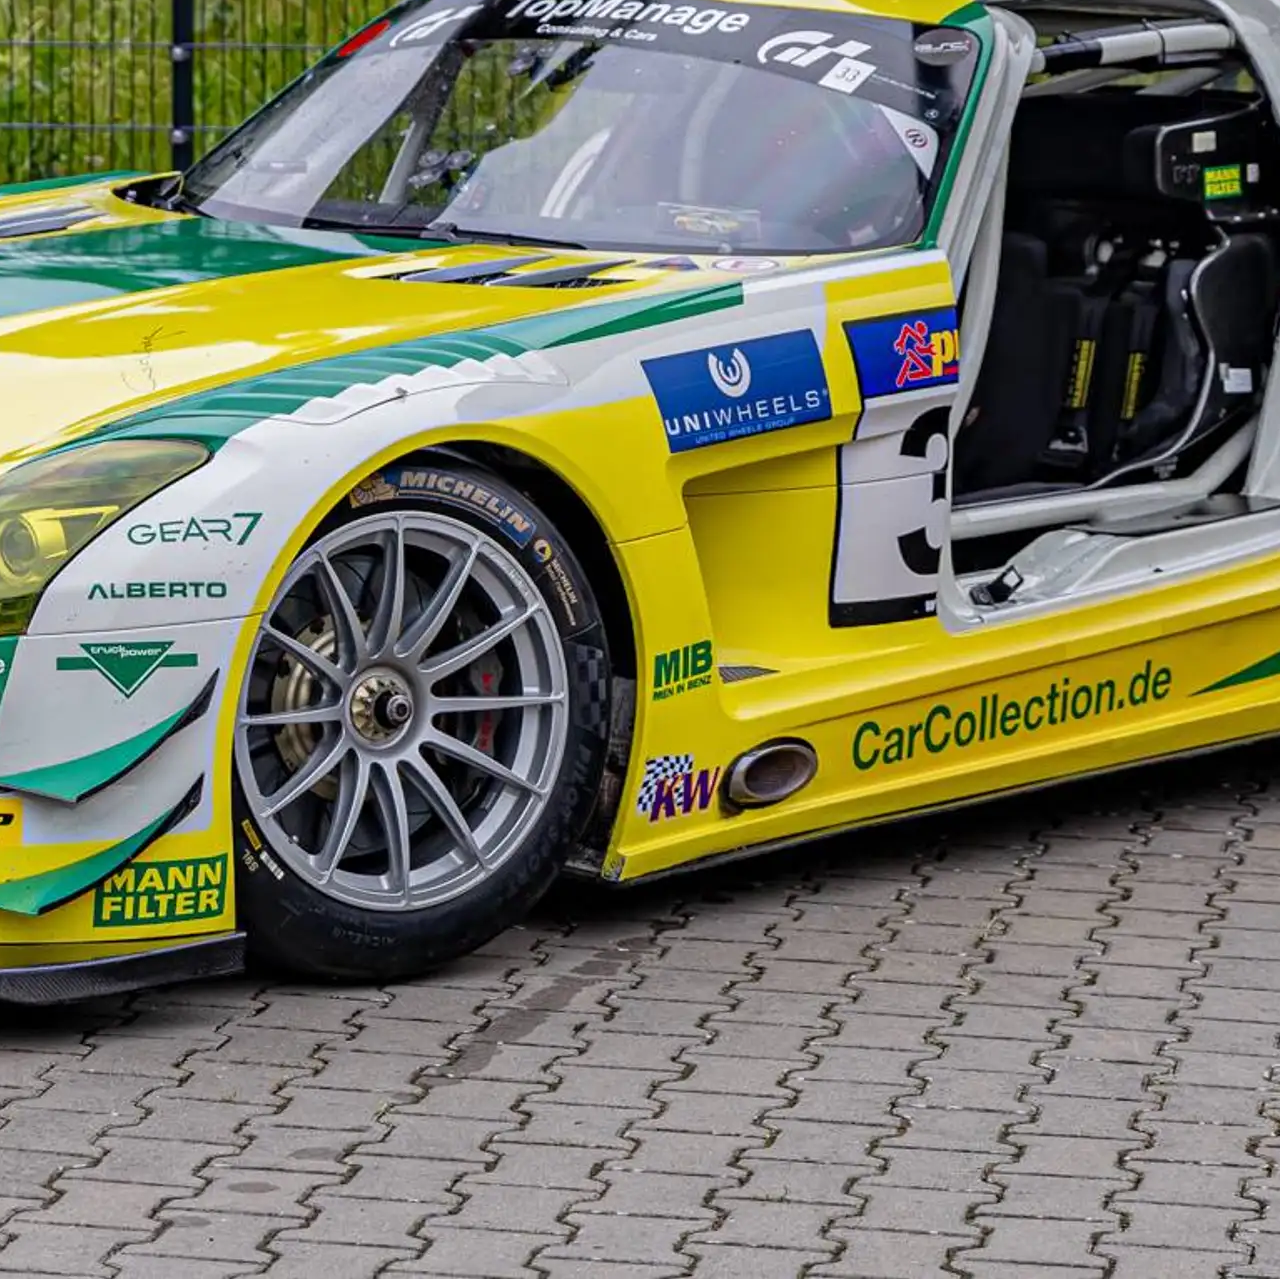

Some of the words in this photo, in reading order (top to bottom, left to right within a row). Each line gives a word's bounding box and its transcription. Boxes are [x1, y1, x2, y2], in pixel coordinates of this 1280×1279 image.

[536, 23, 609, 38] Consulting
[624, 28, 658, 41] Cars
[665, 390, 820, 435] UNIWHEELS
[400, 471, 531, 532] MICHELIN
[127, 512, 263, 546] GEAR7
[88, 582, 227, 600] ALBERTO
[654, 639, 713, 689] MIB
[653, 686, 674, 701] MEN
[676, 683, 685, 694] IN
[687, 675, 712, 691] BENZ
[851, 660, 1172, 770] CarCollection.de
[649, 766, 721, 823] KW
[104, 862, 222, 893] MANN
[102, 889, 219, 920] FILTER
